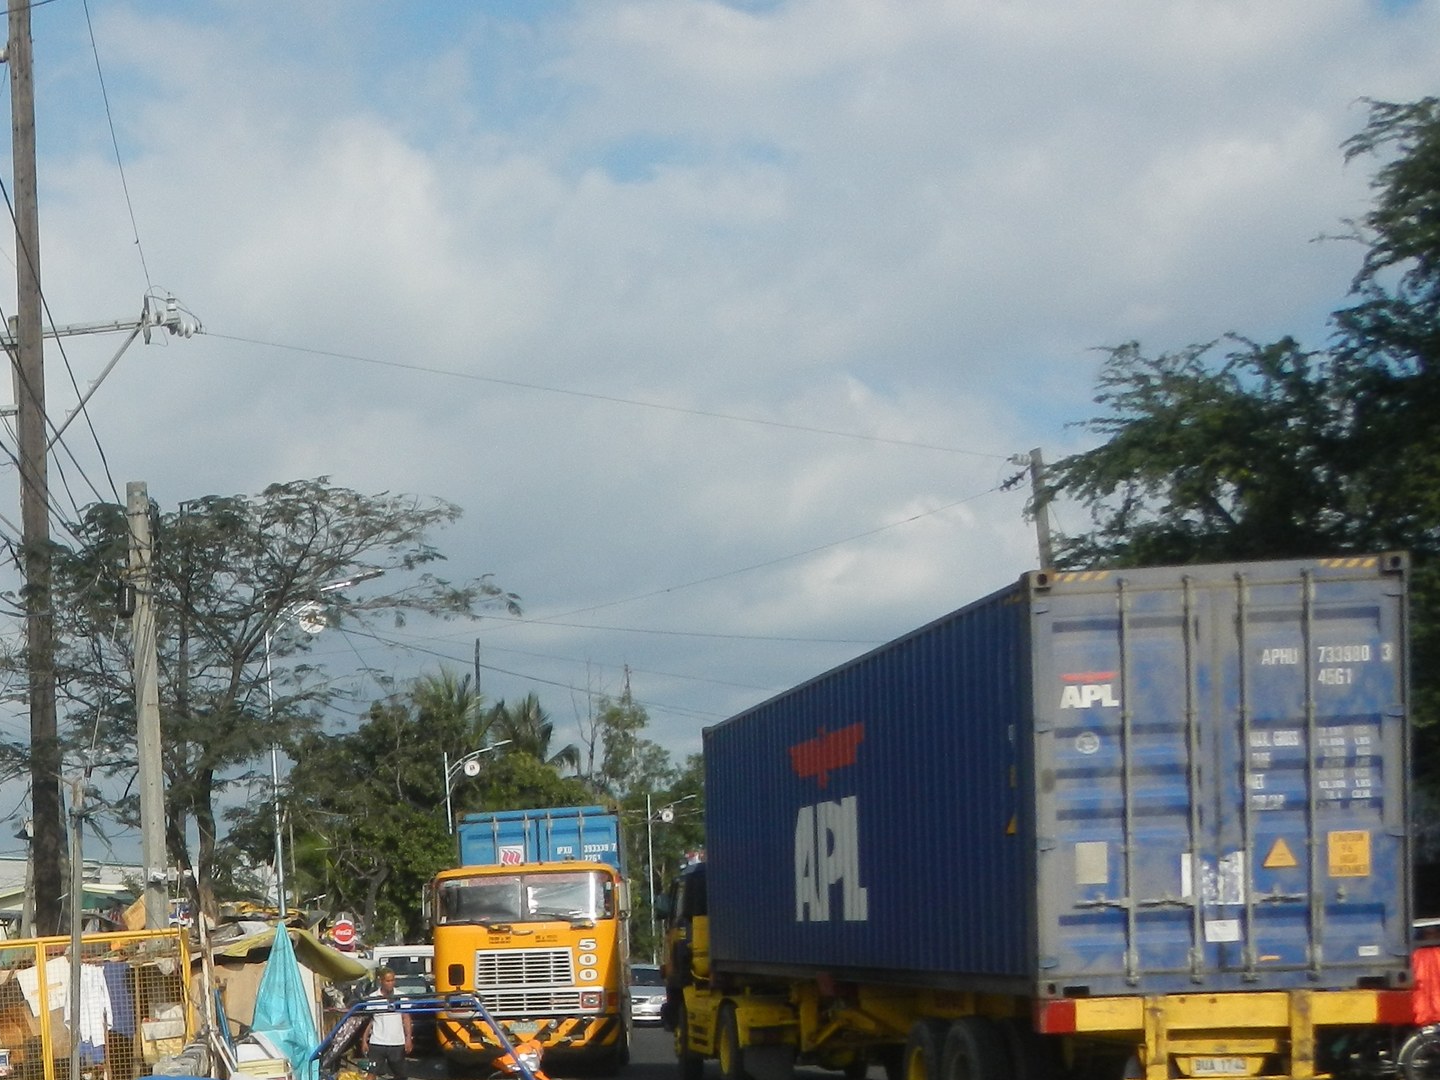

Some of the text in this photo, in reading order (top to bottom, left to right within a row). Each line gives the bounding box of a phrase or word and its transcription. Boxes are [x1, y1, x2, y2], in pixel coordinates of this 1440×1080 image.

[1261, 648, 1298, 665] APHU
[1060, 683, 1120, 710] APL
[794, 795, 869, 923] APL
